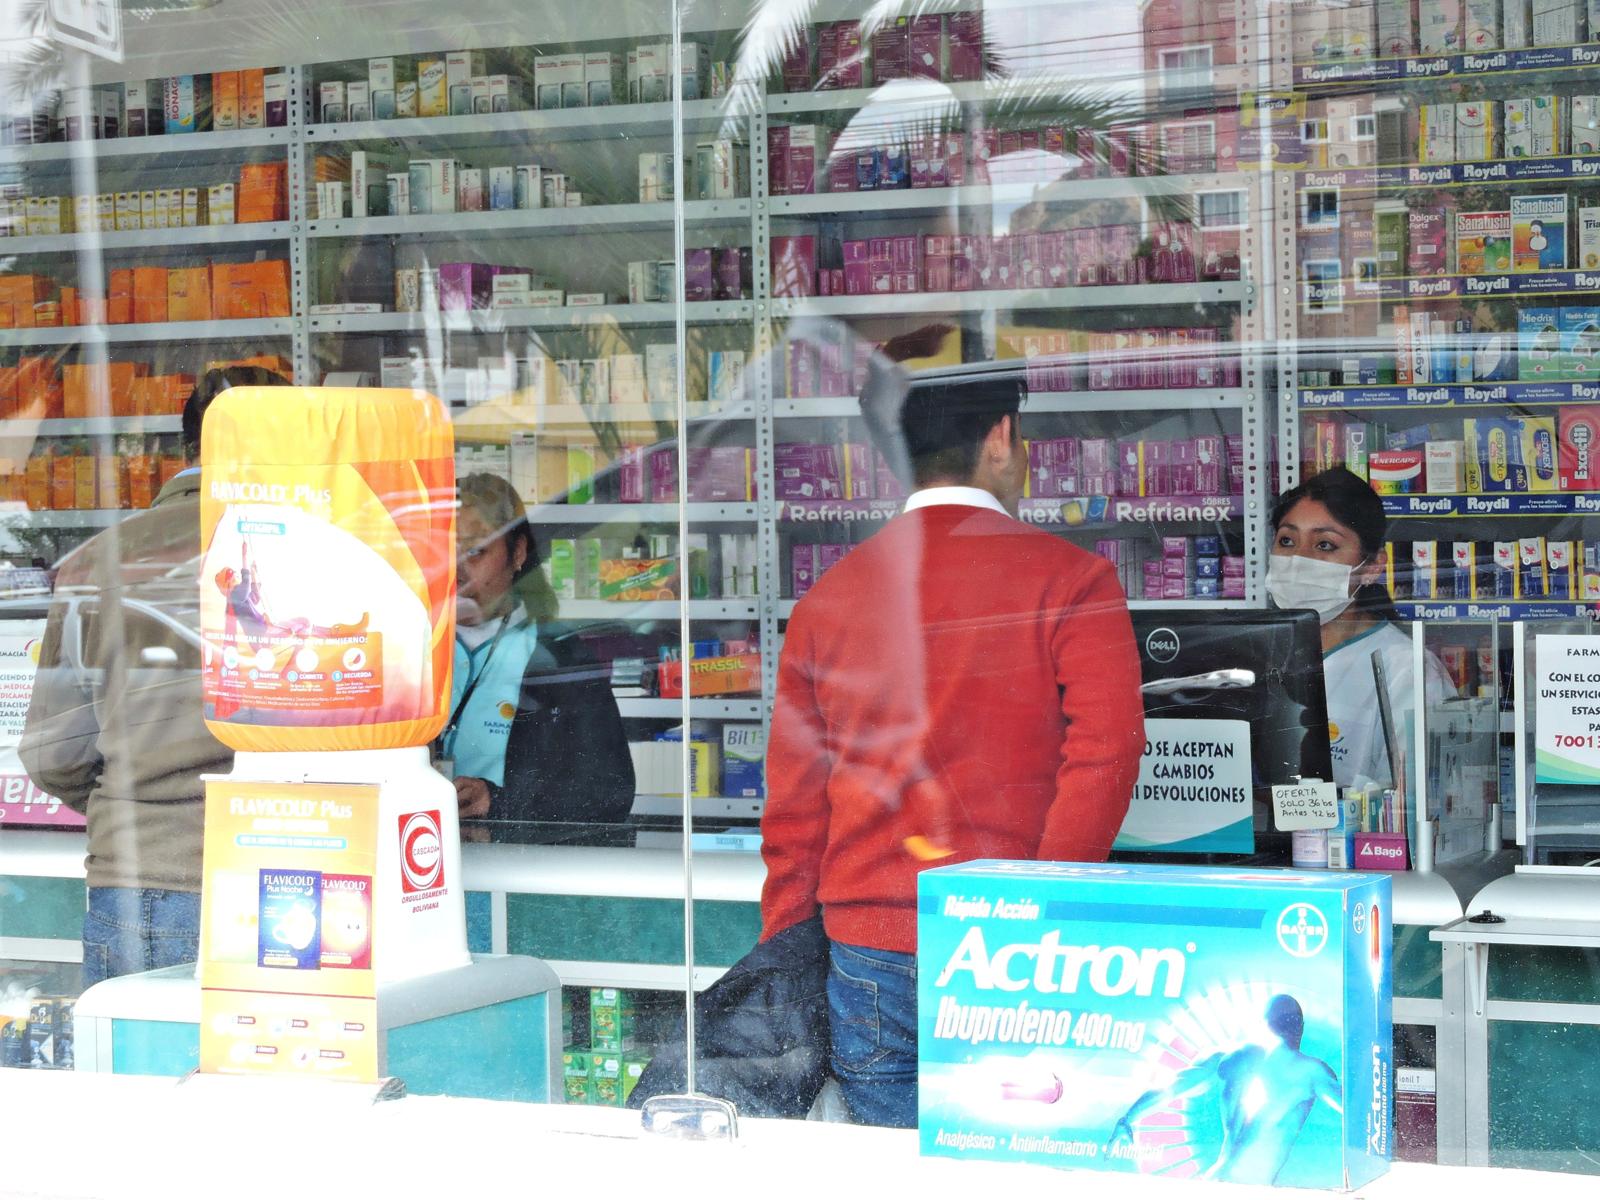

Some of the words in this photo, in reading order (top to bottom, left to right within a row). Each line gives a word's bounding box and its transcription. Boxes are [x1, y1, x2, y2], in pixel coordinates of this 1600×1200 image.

[1406, 60, 1450, 75] Roydil
[1463, 54, 1507, 70] Roydil
[1302, 65, 1344, 82] Roydil
[1304, 172, 1346, 186] Roydil
[1409, 168, 1452, 184] Roydil
[1463, 164, 1507, 181] Roydil
[1513, 198, 1563, 214] Sanatusin
[1409, 213, 1440, 223] Dolgex
[1458, 215, 1510, 231] Sanatusin
[1409, 280, 1450, 295] Roydil
[1467, 277, 1510, 293] Roydil
[1522, 313, 1554, 323] Hiedrix
[1303, 390, 1345, 405] Roydil
[1407, 388, 1449, 404] Roydil
[1464, 386, 1508, 402] Roydil
[1202, 497, 1231, 505] SOBRES
[1409, 497, 1452, 513] Roydil
[1467, 497, 1510, 513] Roydil
[1116, 501, 1232, 522] Refrianex
[1414, 605, 1457, 620] Roydil
[1150, 641, 1176, 650] DELL
[691, 658, 746, 674] TRASSIL
[1549, 672, 1571, 682] CON
[1574, 673, 1585, 682] EL
[1541, 689, 1557, 698] UN
[1156, 741, 1169, 757] SE
[1172, 741, 1234, 758] ACEPTAN
[1153, 763, 1215, 780] CAMBIOS
[1144, 785, 1246, 803] DEVOLUCIONES
[1275, 787, 1318, 799] OFERTA
[229, 797, 316, 817] FLAVICOLD
[320, 798, 353, 819] Plus
[1280, 799, 1305, 807] SOLO
[1308, 798, 1321, 807] 36
[1282, 809, 1308, 817] Antes
[1374, 846, 1402, 858] Bagó
[264, 874, 314, 887] FLAVICOLD
[321, 879, 366, 891] FLAVICOLD
[401, 888, 449, 904] ORGULLOSAMENTE
[412, 902, 440, 914] BOLIVIANA
[943, 895, 991, 921] Rápida
[992, 896, 1040, 921] Acción
[934, 926, 1187, 998] Actron
[934, 996, 1072, 1045] Ibuprofeno
[1072, 1012, 1113, 1049] 400
[1112, 1021, 1146, 1053] mg
[1371, 1044, 1381, 1155] Actron
[935, 1128, 996, 1151] Analgésico
